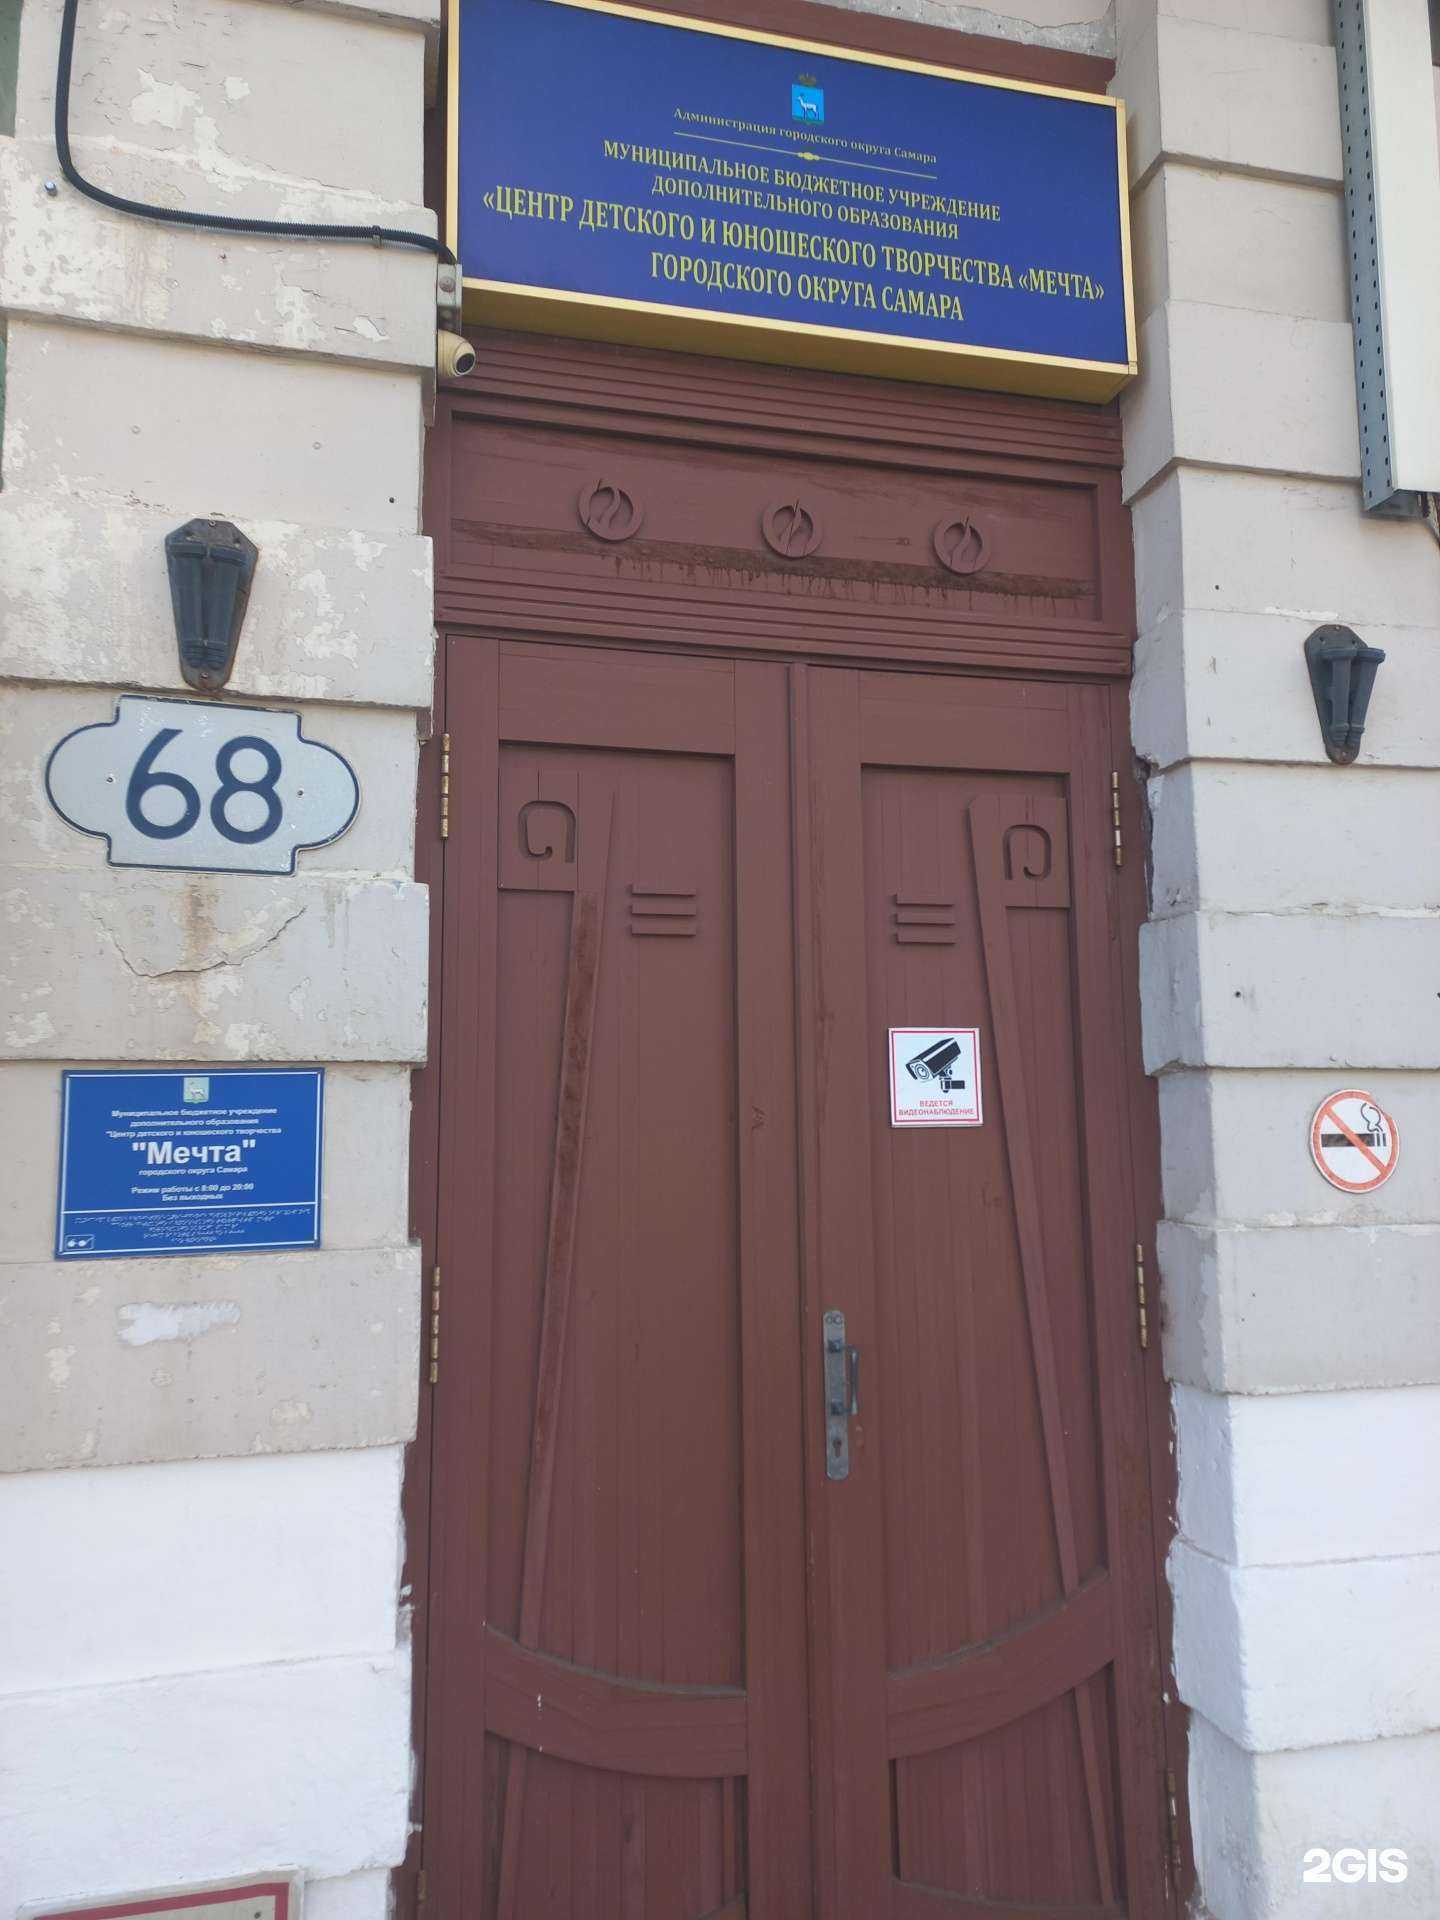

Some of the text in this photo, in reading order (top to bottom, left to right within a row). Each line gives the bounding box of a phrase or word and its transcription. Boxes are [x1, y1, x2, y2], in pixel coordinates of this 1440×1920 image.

[672, 107, 938, 165] Администрация городского округа Самара
[603, 139, 1001, 222] МУНИЦИПАЛЬНОЕ БЮДЖЕТНОЕ УЧРЕЖДЕНИЕ
[651, 175, 960, 240] ДОПОЛНИТЕЛЬНОГО ОБРАЗОВАНИЯ
[483, 185, 1105, 301] «ЦЕНТР ДЕТСКОГО И ЮНОШЕСКОГО ТВОРЧЕСТВА «МЕЧТА»
[651, 251, 966, 322] ГОРОДСКОГО ОКРУГА САМАРА
[125, 728, 283, 845] 68
[132, 1139, 256, 1164] "Мечта"
[136, 1130, 175, 1138] детского
[235, 1127, 282, 1136] творчества
[138, 1166, 248, 1176] городского округа Самара
[160, 1185, 194, 1194] работы
[219, 1184, 231, 1192] до
[162, 1193, 178, 1202] Без
